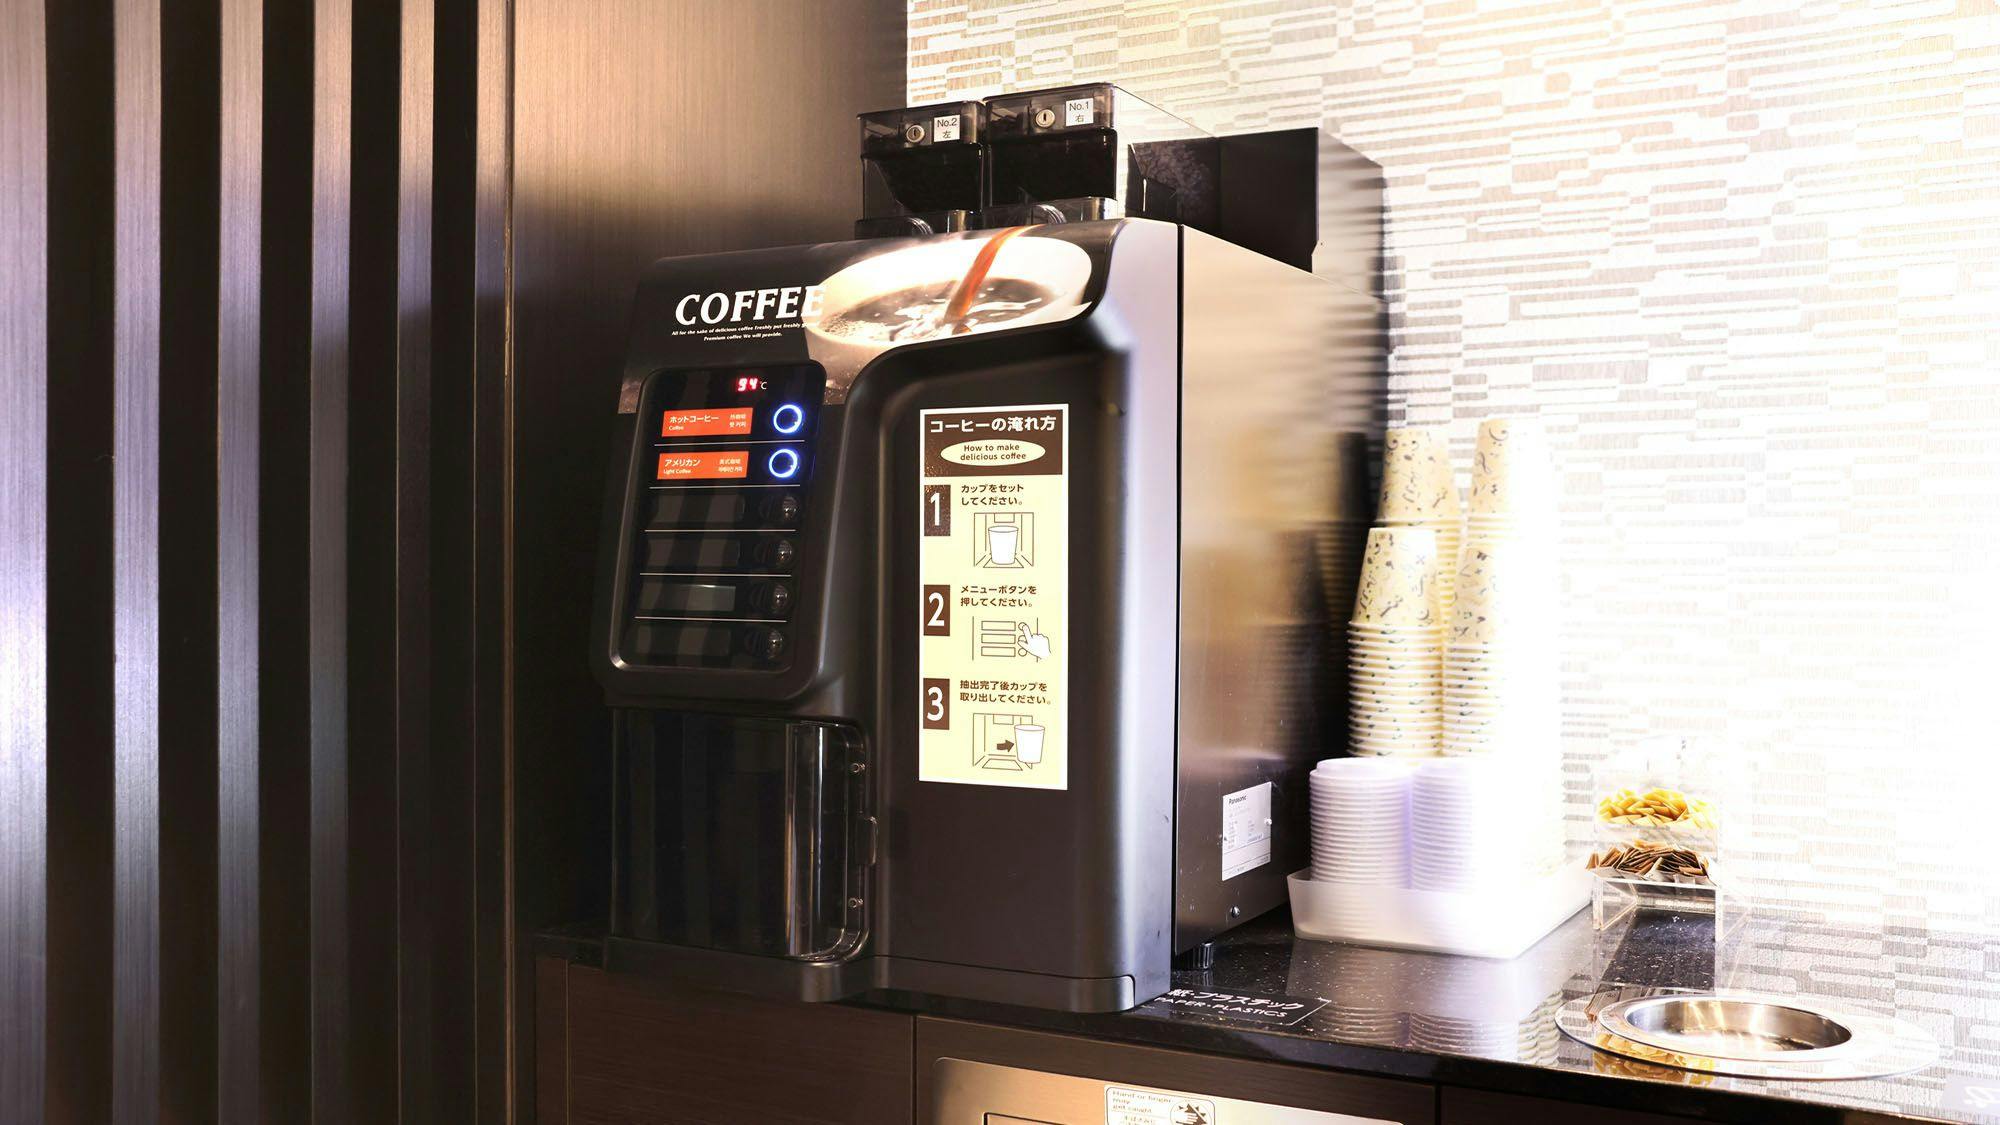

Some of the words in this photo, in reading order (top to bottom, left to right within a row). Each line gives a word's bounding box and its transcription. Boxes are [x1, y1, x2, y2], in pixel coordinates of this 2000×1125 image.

[1069, 101, 1089, 111] No.1
[937, 117, 957, 127] No.2
[1075, 114, 1084, 123] 右
[942, 130, 952, 139] 左
[675, 285, 826, 326] COFFEE
[738, 378, 758, 392] 94
[670, 415, 719, 424] ホットコーヒー
[930, 416, 1056, 433] コーヒーの淹れ方
[996, 443, 1020, 451] make
[960, 453, 998, 461] delicious
[1000, 452, 1027, 460] coffee
[664, 459, 701, 467] アメリカン
[961, 484, 1024, 494] カップをセット
[961, 496, 1023, 506] してください。
[930, 492, 941, 526] 1
[960, 585, 1037, 595] メニューボタンを
[960, 597, 1033, 608] 押してください。
[927, 592, 945, 627] 2
[960, 680, 1048, 692] 抽出完了後カップを
[927, 686, 944, 721] 3
[960, 692, 1051, 705] 取り出してください。
[1228, 795, 1247, 805] Panasonic
